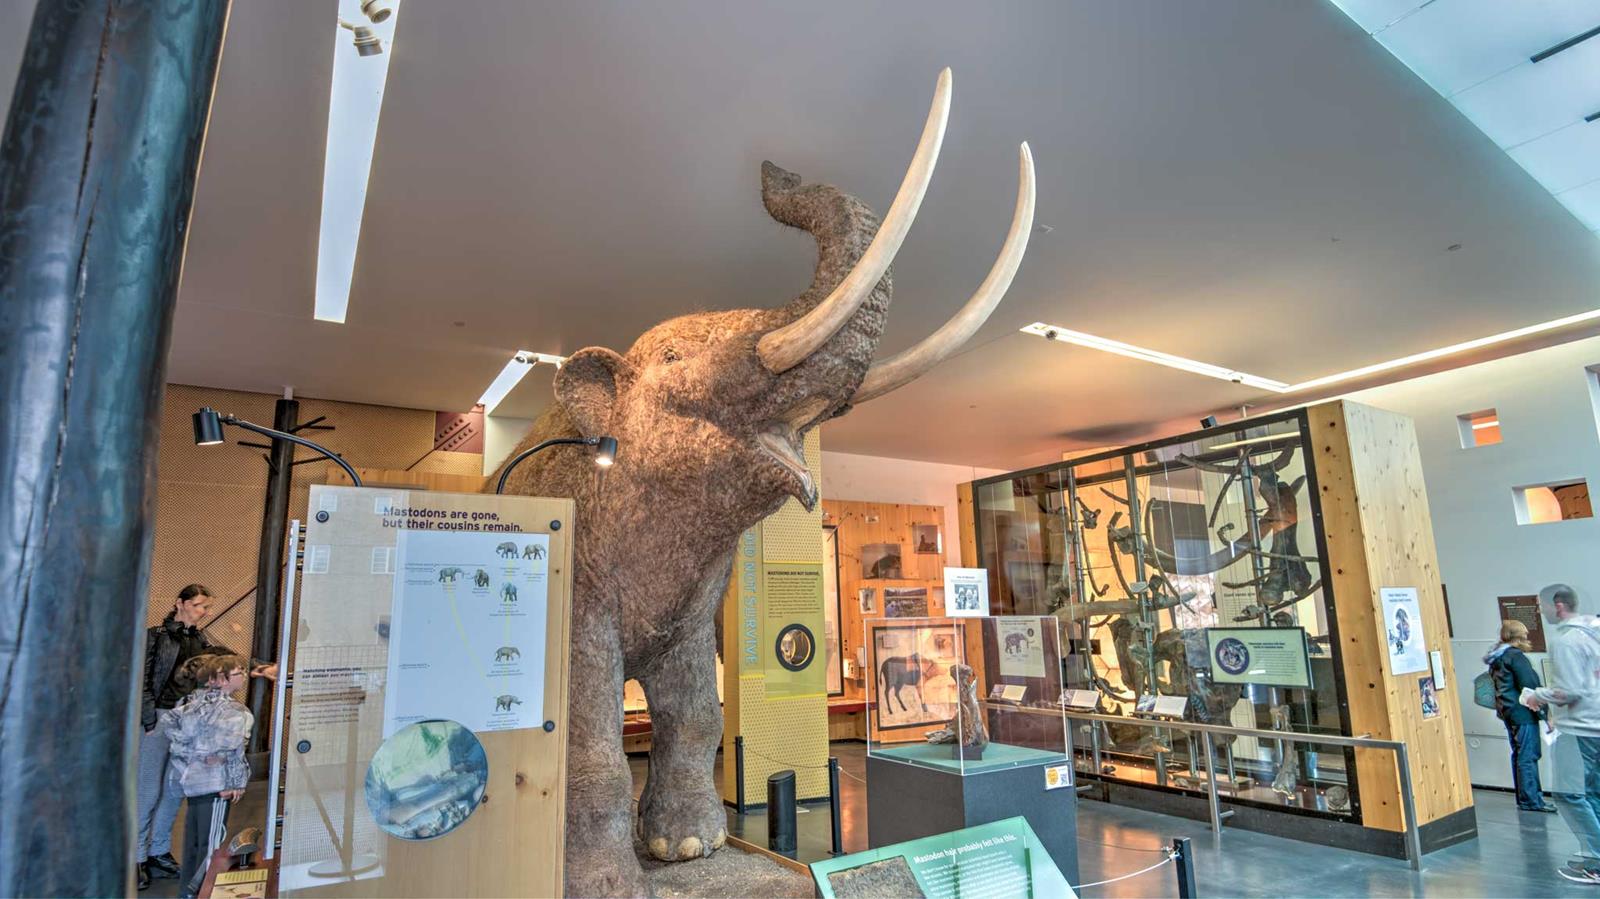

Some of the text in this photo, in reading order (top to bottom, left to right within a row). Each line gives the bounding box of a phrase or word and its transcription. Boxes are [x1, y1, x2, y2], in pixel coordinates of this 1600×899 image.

[382, 518, 523, 532] but their cousins remain.
[383, 506, 500, 521] Mastodons are gone,
[744, 562, 756, 592] NOT
[744, 596, 758, 664] SURVIVE
[913, 851, 945, 864] Mastodon
[944, 847, 957, 856] hair
[957, 842, 983, 854] probably
[992, 836, 1004, 845] like
